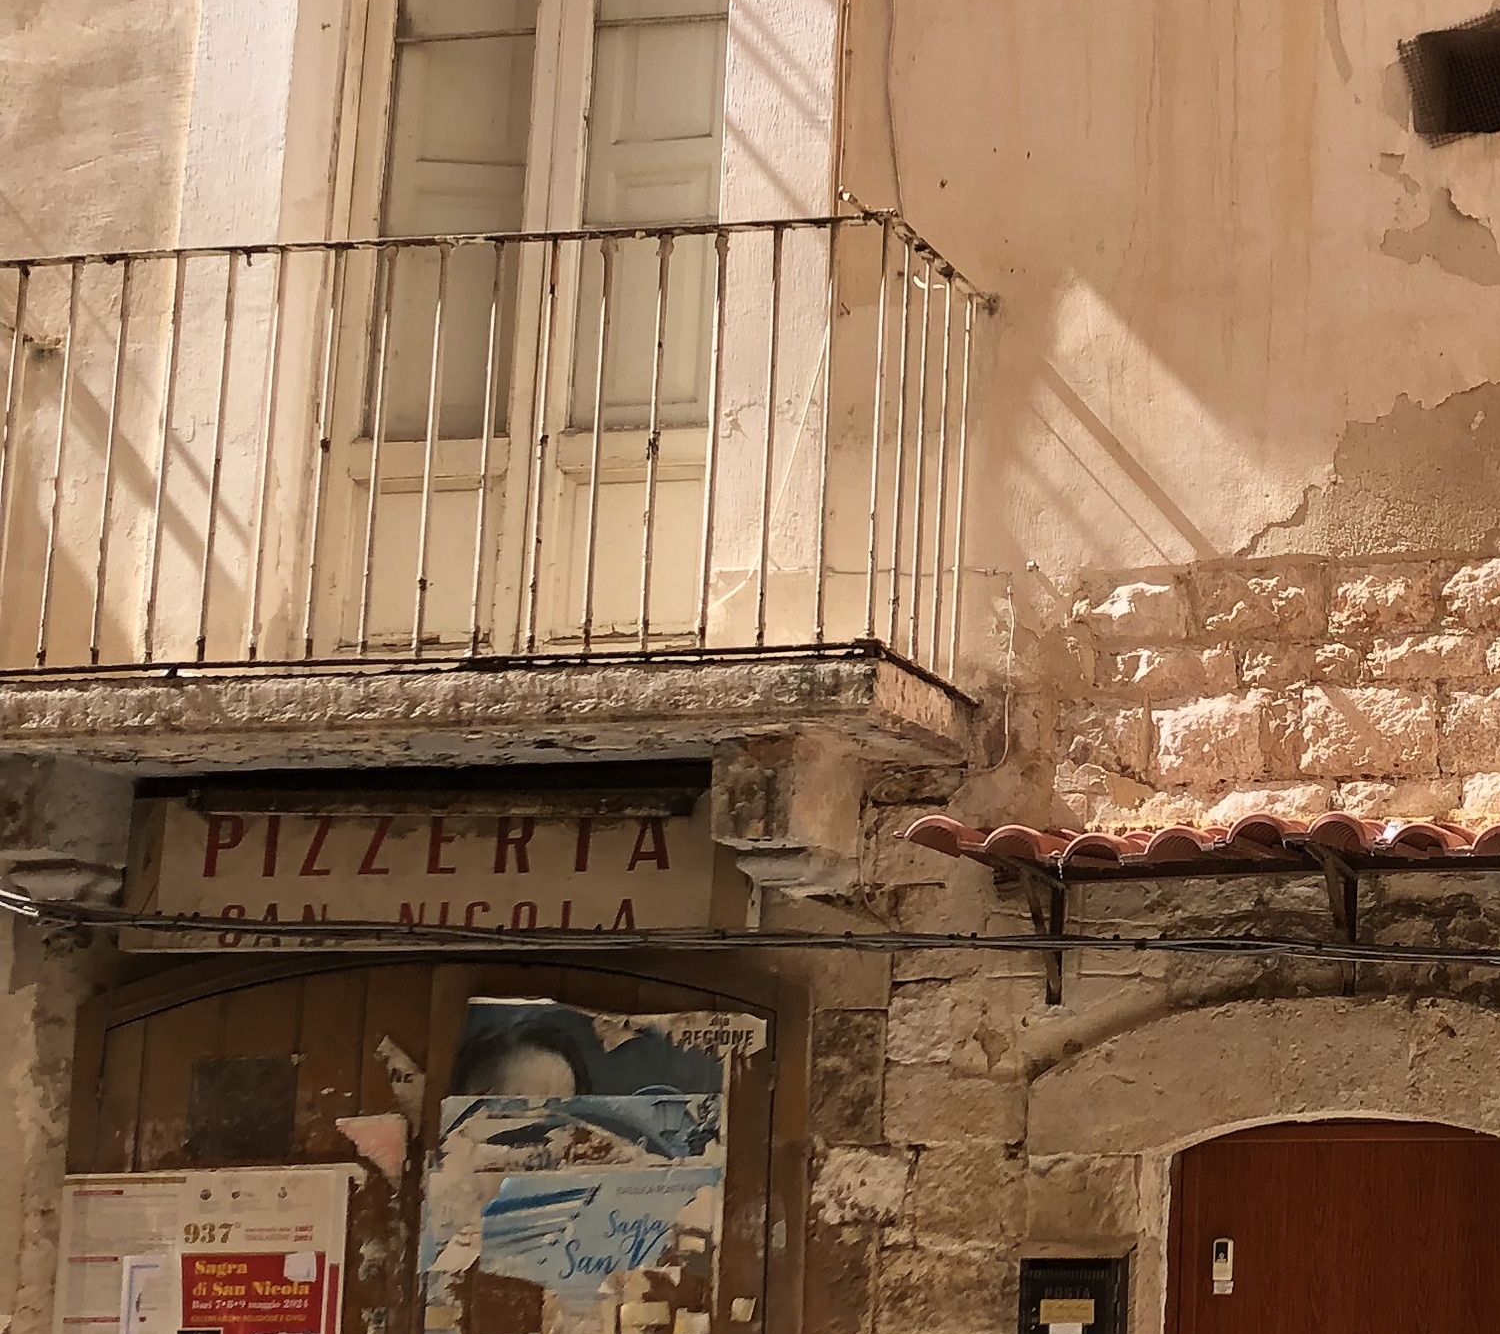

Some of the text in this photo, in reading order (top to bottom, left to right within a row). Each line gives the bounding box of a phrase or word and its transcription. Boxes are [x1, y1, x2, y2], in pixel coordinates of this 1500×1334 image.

[202, 813, 670, 878] PIZZERIA
[603, 1209, 669, 1255] Sagra
[194, 1259, 248, 1277] Sagra
[558, 1238, 622, 1280] San
[192, 1279, 310, 1297] di San Nicola
